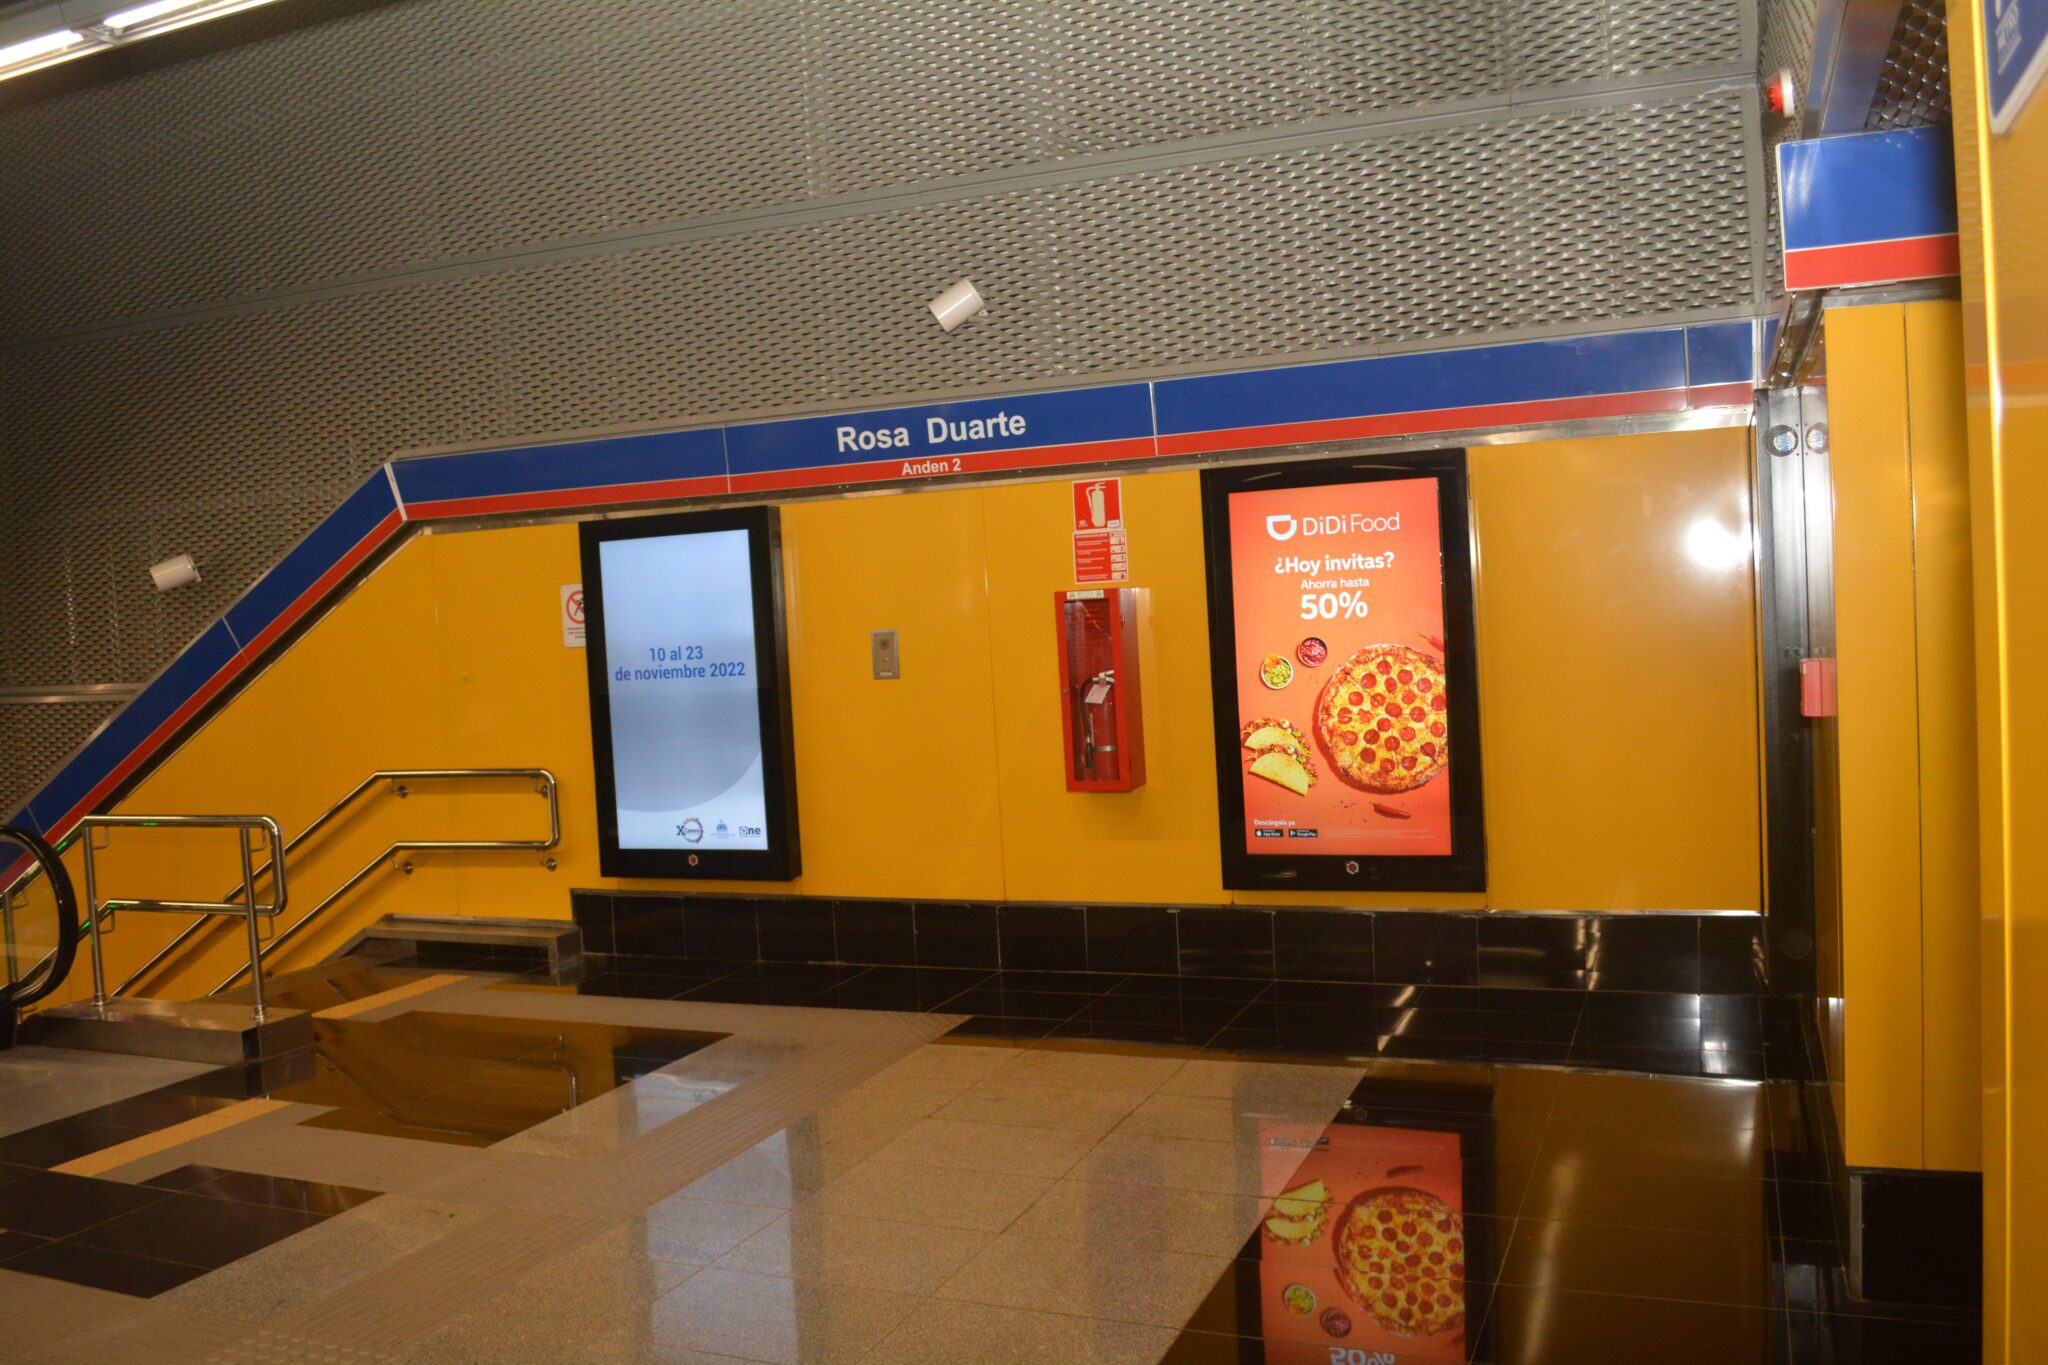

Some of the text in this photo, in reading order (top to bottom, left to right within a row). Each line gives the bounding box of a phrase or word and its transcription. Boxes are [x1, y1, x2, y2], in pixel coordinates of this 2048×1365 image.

[836, 411, 1027, 452] Rosa Duarte
[901, 458, 961, 476] Anden 2
[1302, 511, 1400, 537] DiDi Food
[1274, 551, 1395, 576] ¿Hoy invitas?
[1300, 577, 1370, 590] Ahorra hasta
[1300, 591, 1368, 620] 50%
[649, 645, 704, 662] 10 al 23
[615, 662, 746, 681] de noviembre 2022
